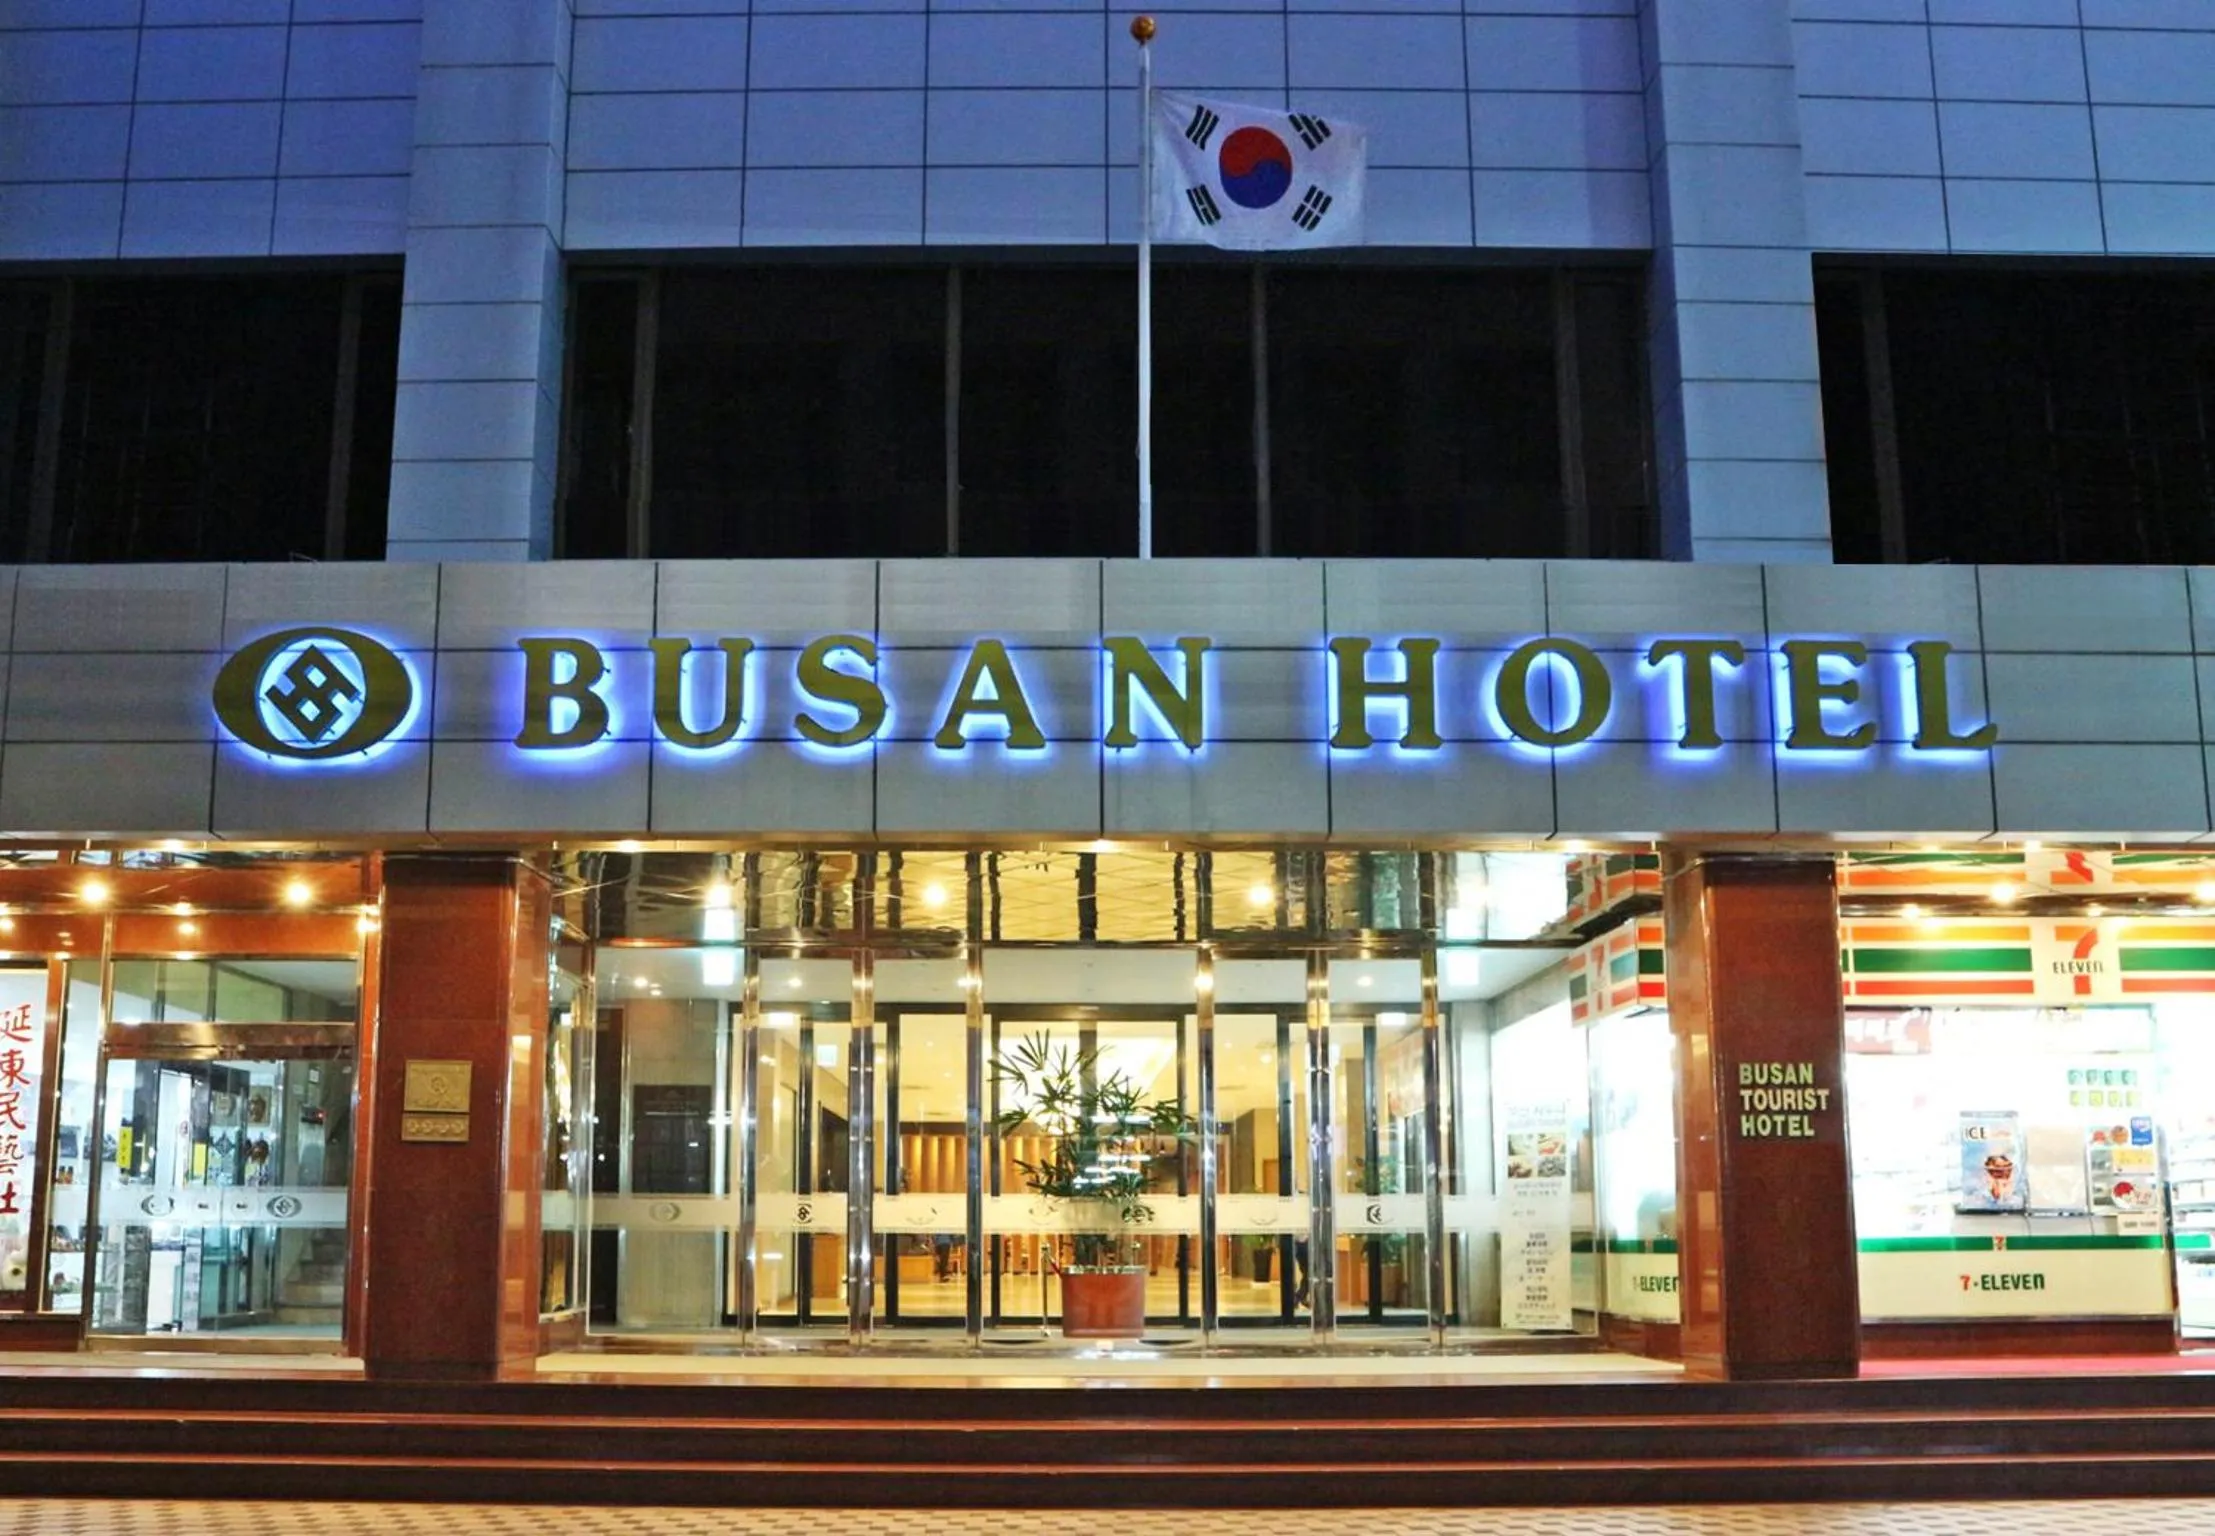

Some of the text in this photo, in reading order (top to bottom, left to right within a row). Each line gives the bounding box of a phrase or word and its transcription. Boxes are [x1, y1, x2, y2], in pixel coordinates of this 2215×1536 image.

[515, 637, 1998, 752] BUSAN HOTEL
[1739, 1063, 1813, 1085] BUSAN
[1740, 1088, 1829, 1111] TOURIST
[1741, 1113, 1815, 1137] HOTEL
